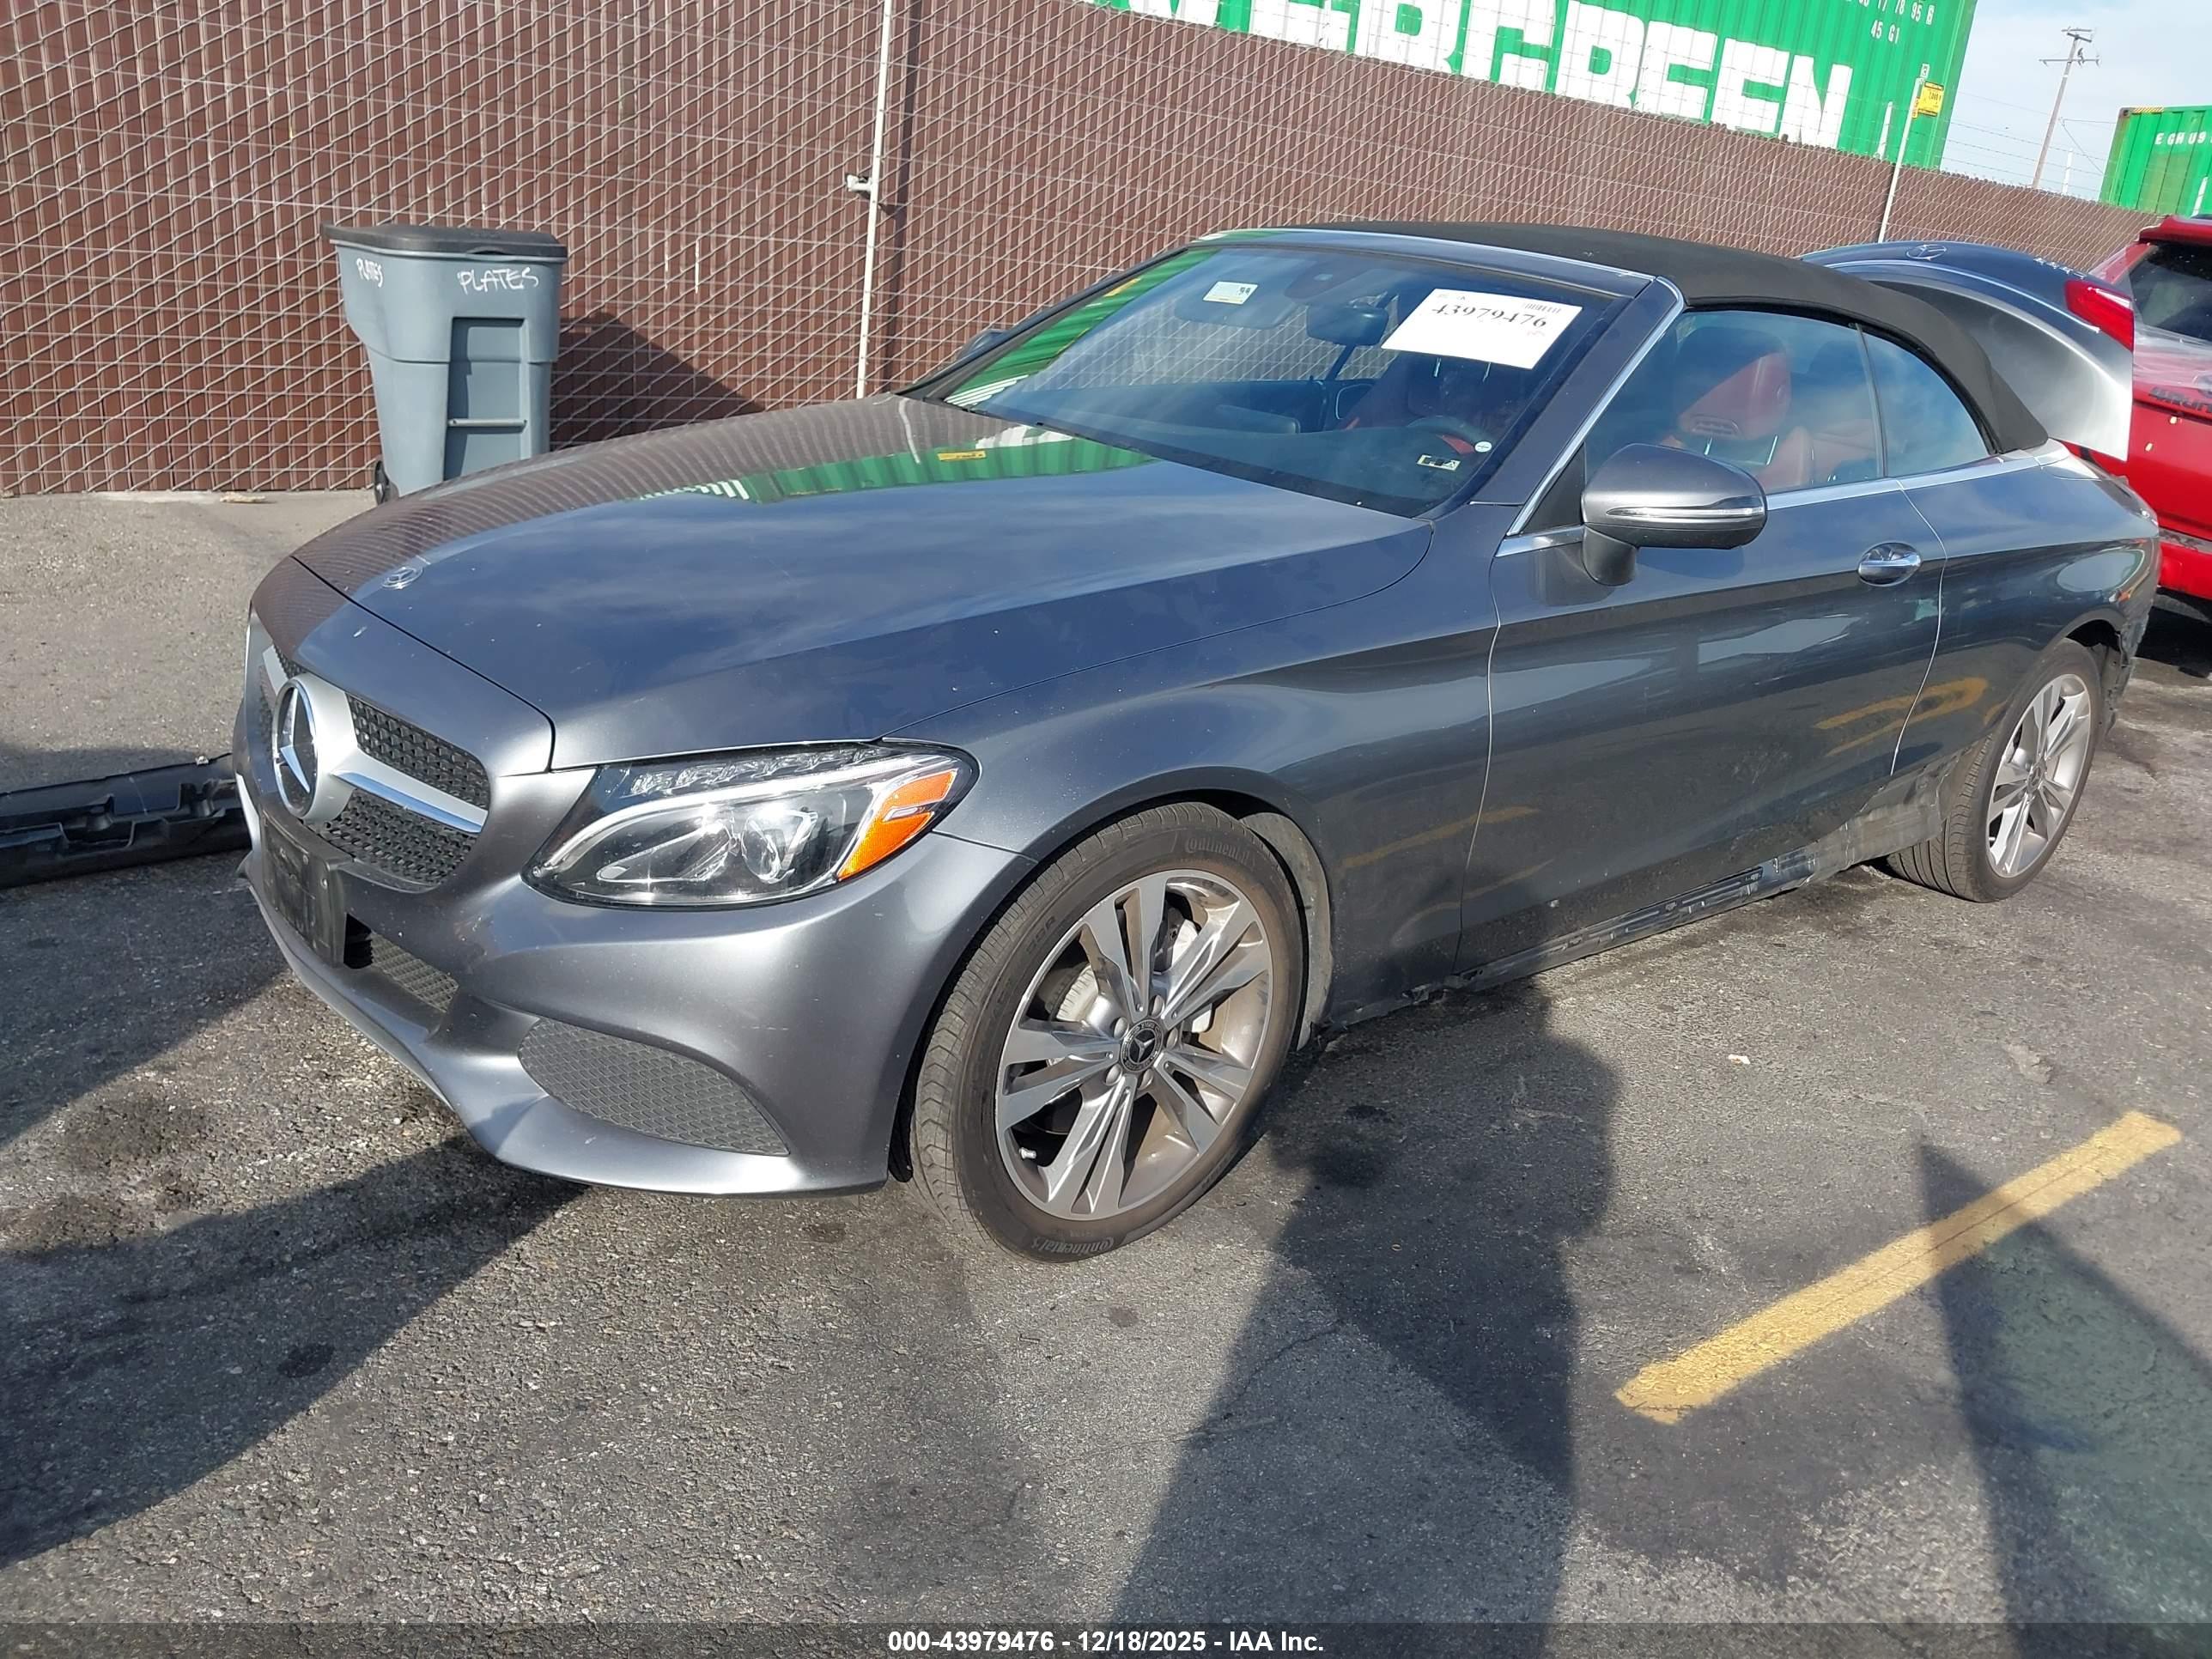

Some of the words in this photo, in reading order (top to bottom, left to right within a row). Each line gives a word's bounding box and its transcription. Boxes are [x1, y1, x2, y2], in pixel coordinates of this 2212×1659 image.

[1871, 20, 1883, 39] 45
[1084, 0, 1853, 149] RGREEN
[457, 266, 539, 295] PLATES
[1431, 304, 1547, 328] 43979476
[1037, 1237, 1115, 1255] Continental
